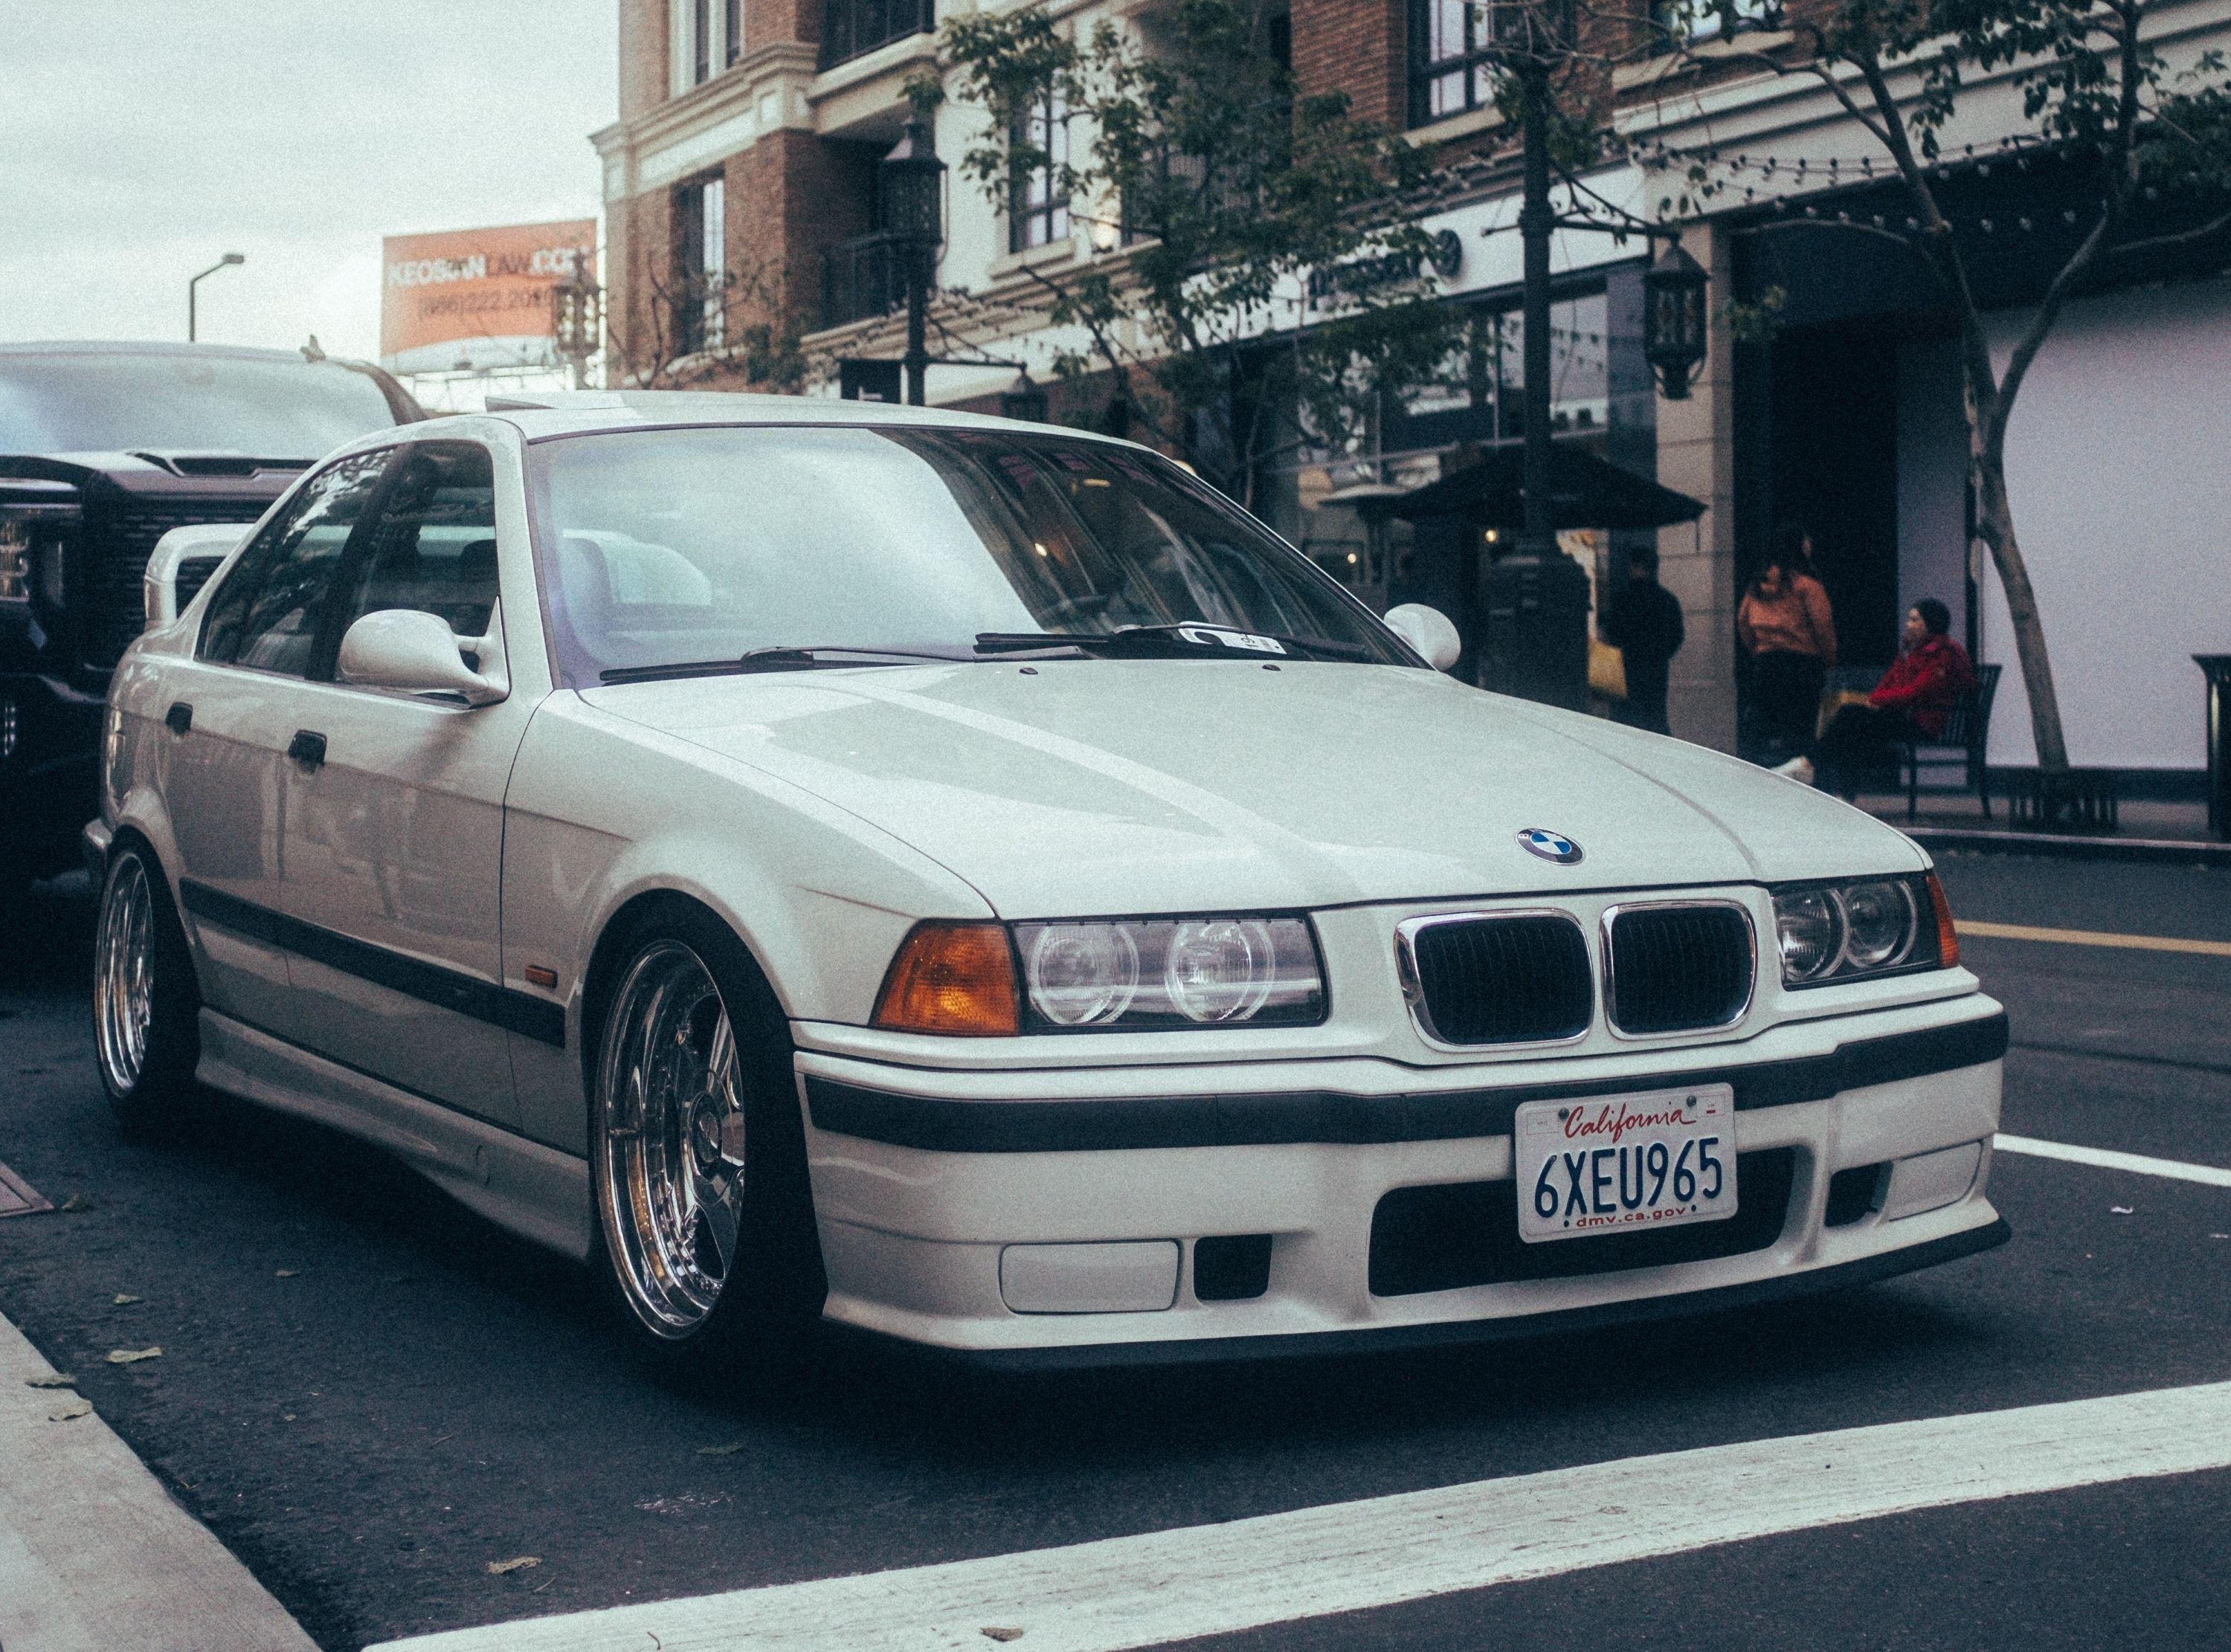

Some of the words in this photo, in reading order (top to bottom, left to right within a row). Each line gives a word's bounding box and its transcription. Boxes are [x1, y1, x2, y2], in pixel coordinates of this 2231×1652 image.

[1565, 1102, 1696, 1143] California
[1534, 1137, 1722, 1219] 6XEU965
[1576, 1205, 1687, 1228] dmv.ca.gov
